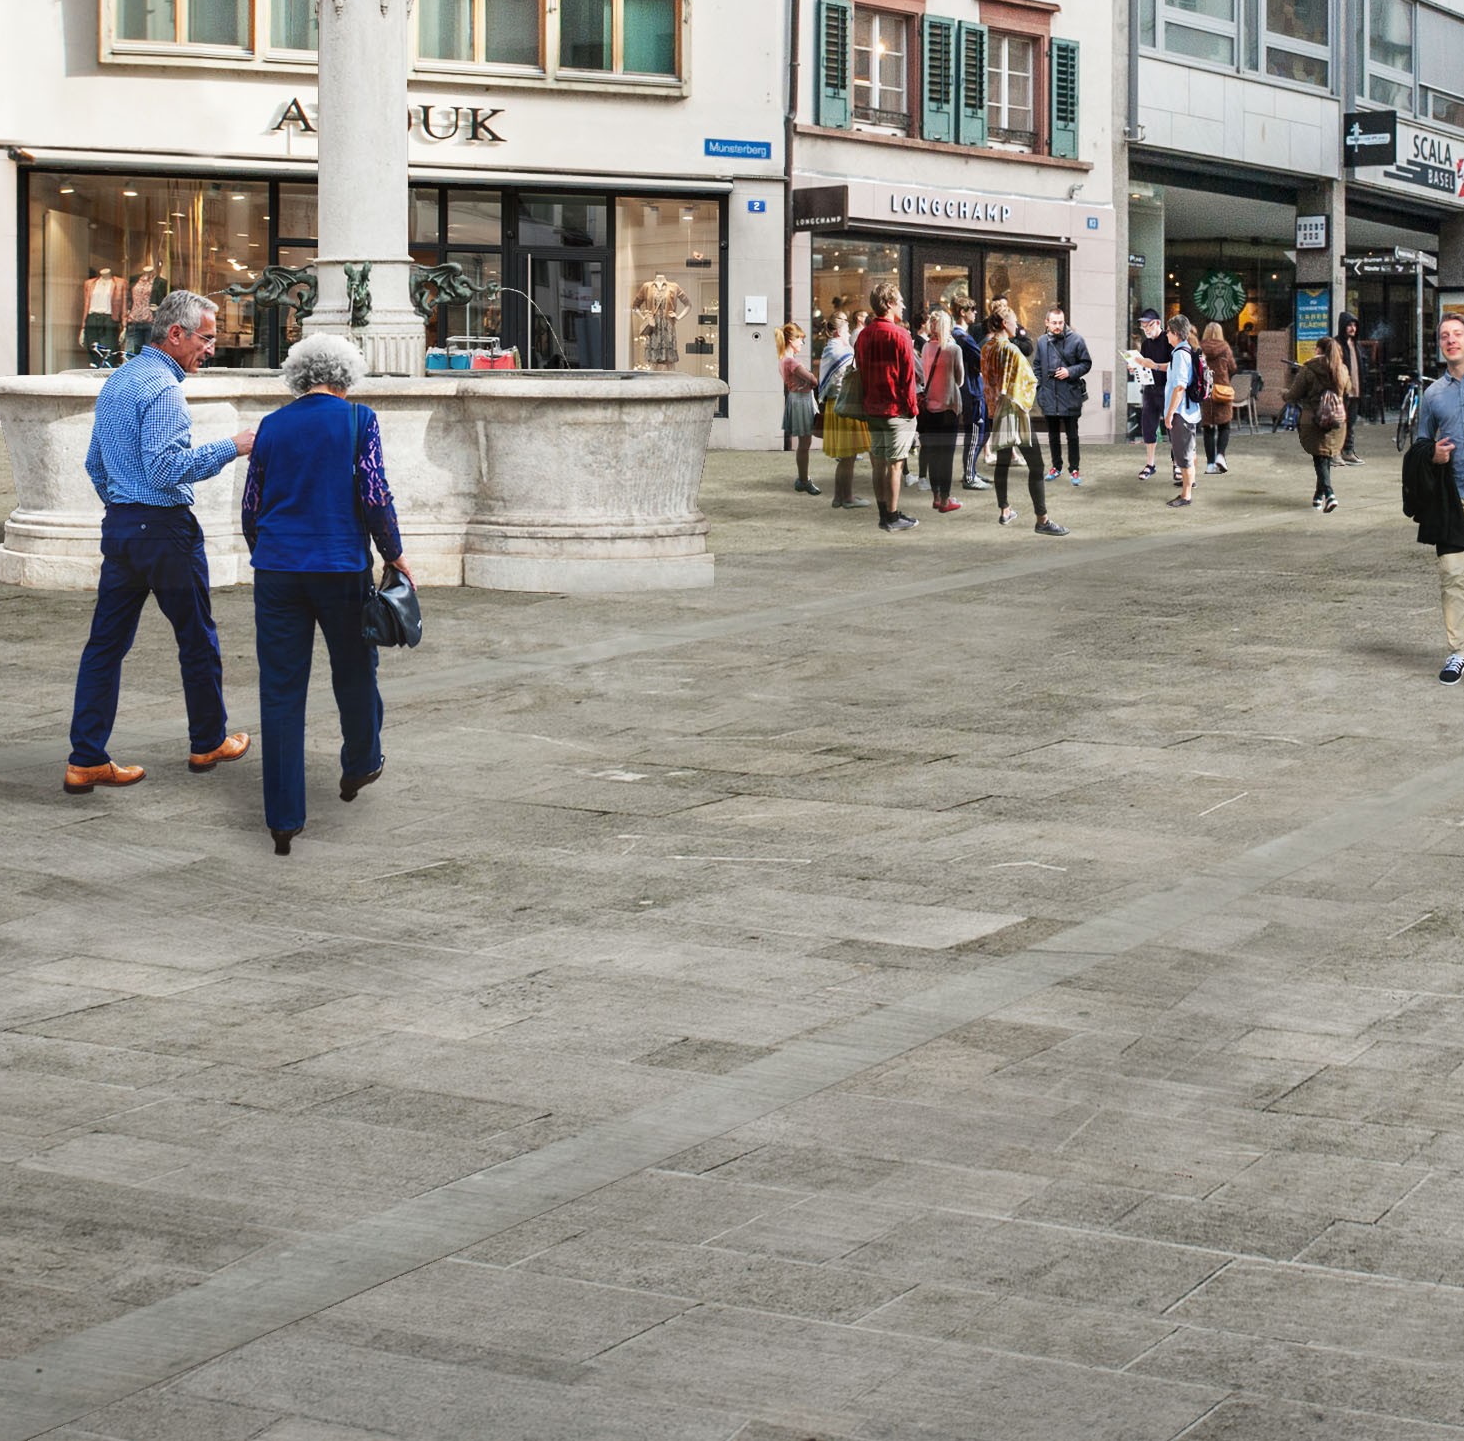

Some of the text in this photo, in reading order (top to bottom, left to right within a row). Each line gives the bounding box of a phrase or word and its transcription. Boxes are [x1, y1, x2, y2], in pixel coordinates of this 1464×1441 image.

[271, 97, 508, 143] AUK
[1413, 134, 1453, 168] SCALA
[1428, 168, 1454, 190] BASEL
[753, 201, 760, 211] 2
[891, 193, 1012, 223] LONGCHAMP
[795, 216, 842, 227] LONGCHAMP
